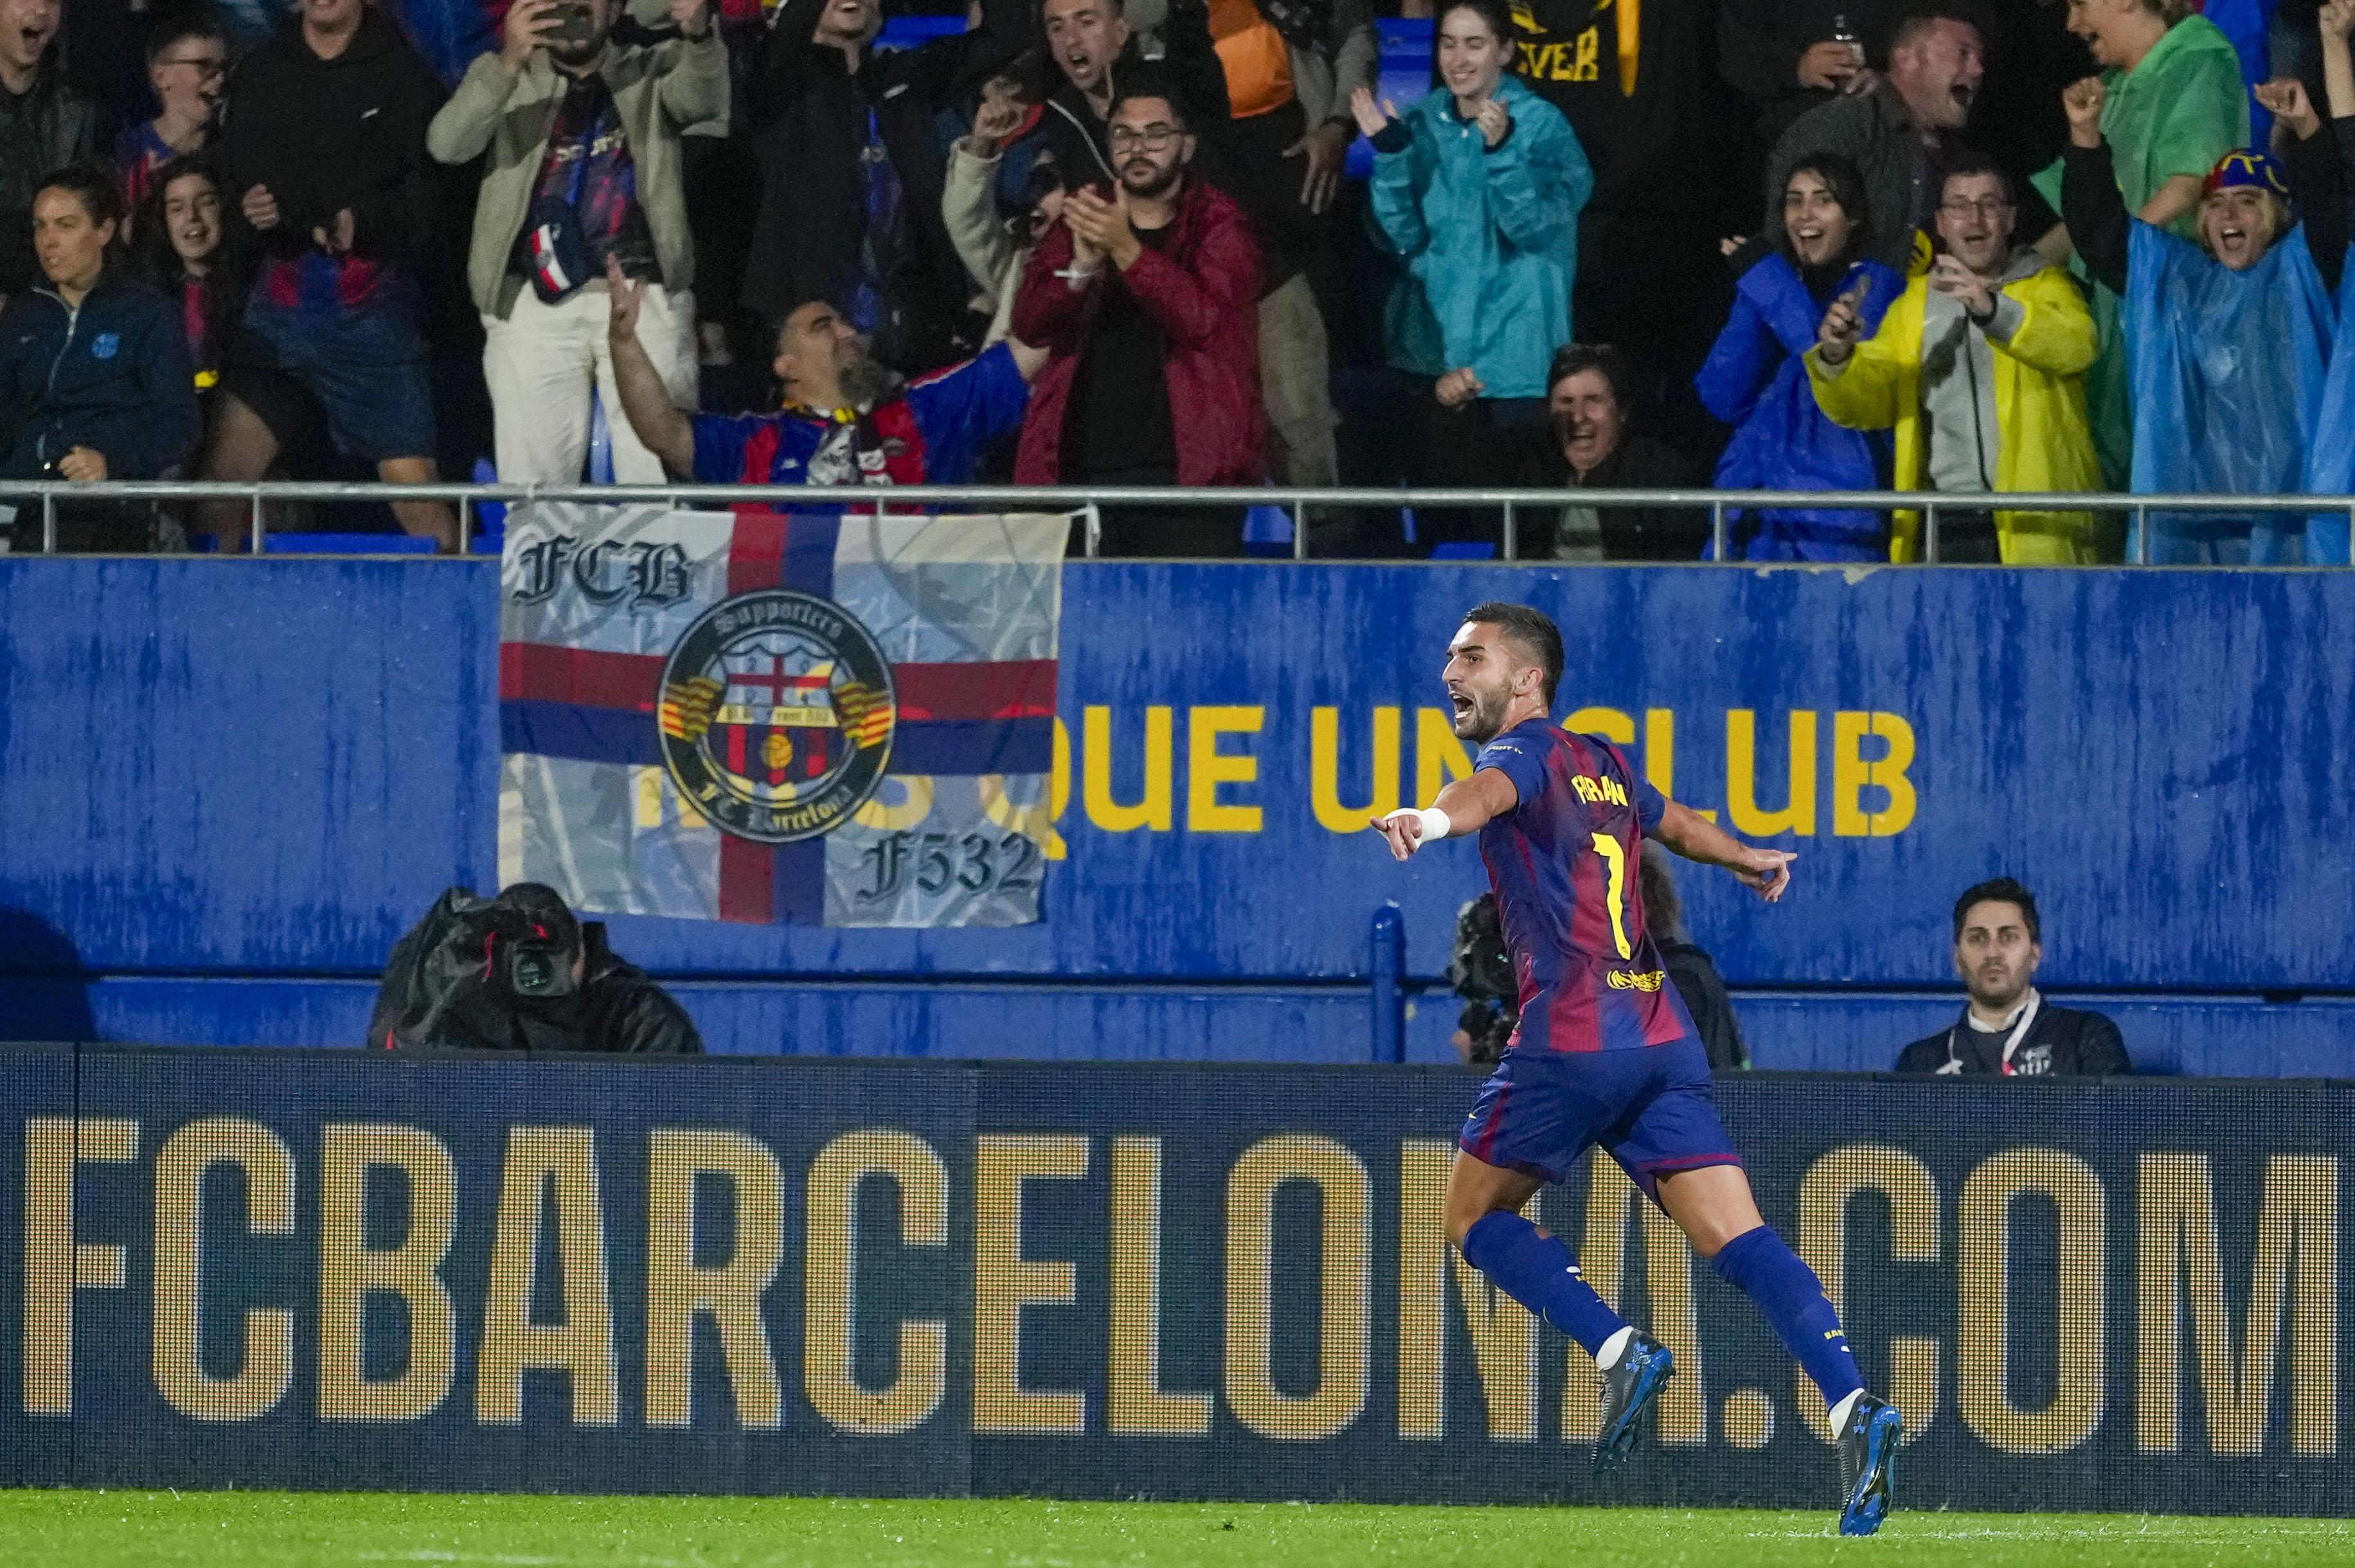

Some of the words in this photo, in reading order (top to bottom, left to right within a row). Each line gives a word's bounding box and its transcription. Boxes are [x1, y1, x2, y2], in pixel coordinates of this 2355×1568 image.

[513, 534, 690, 611] FCB
[856, 830, 1032, 898] F532
[22, 1115, 2338, 1458] FCBARCELONA.COM
